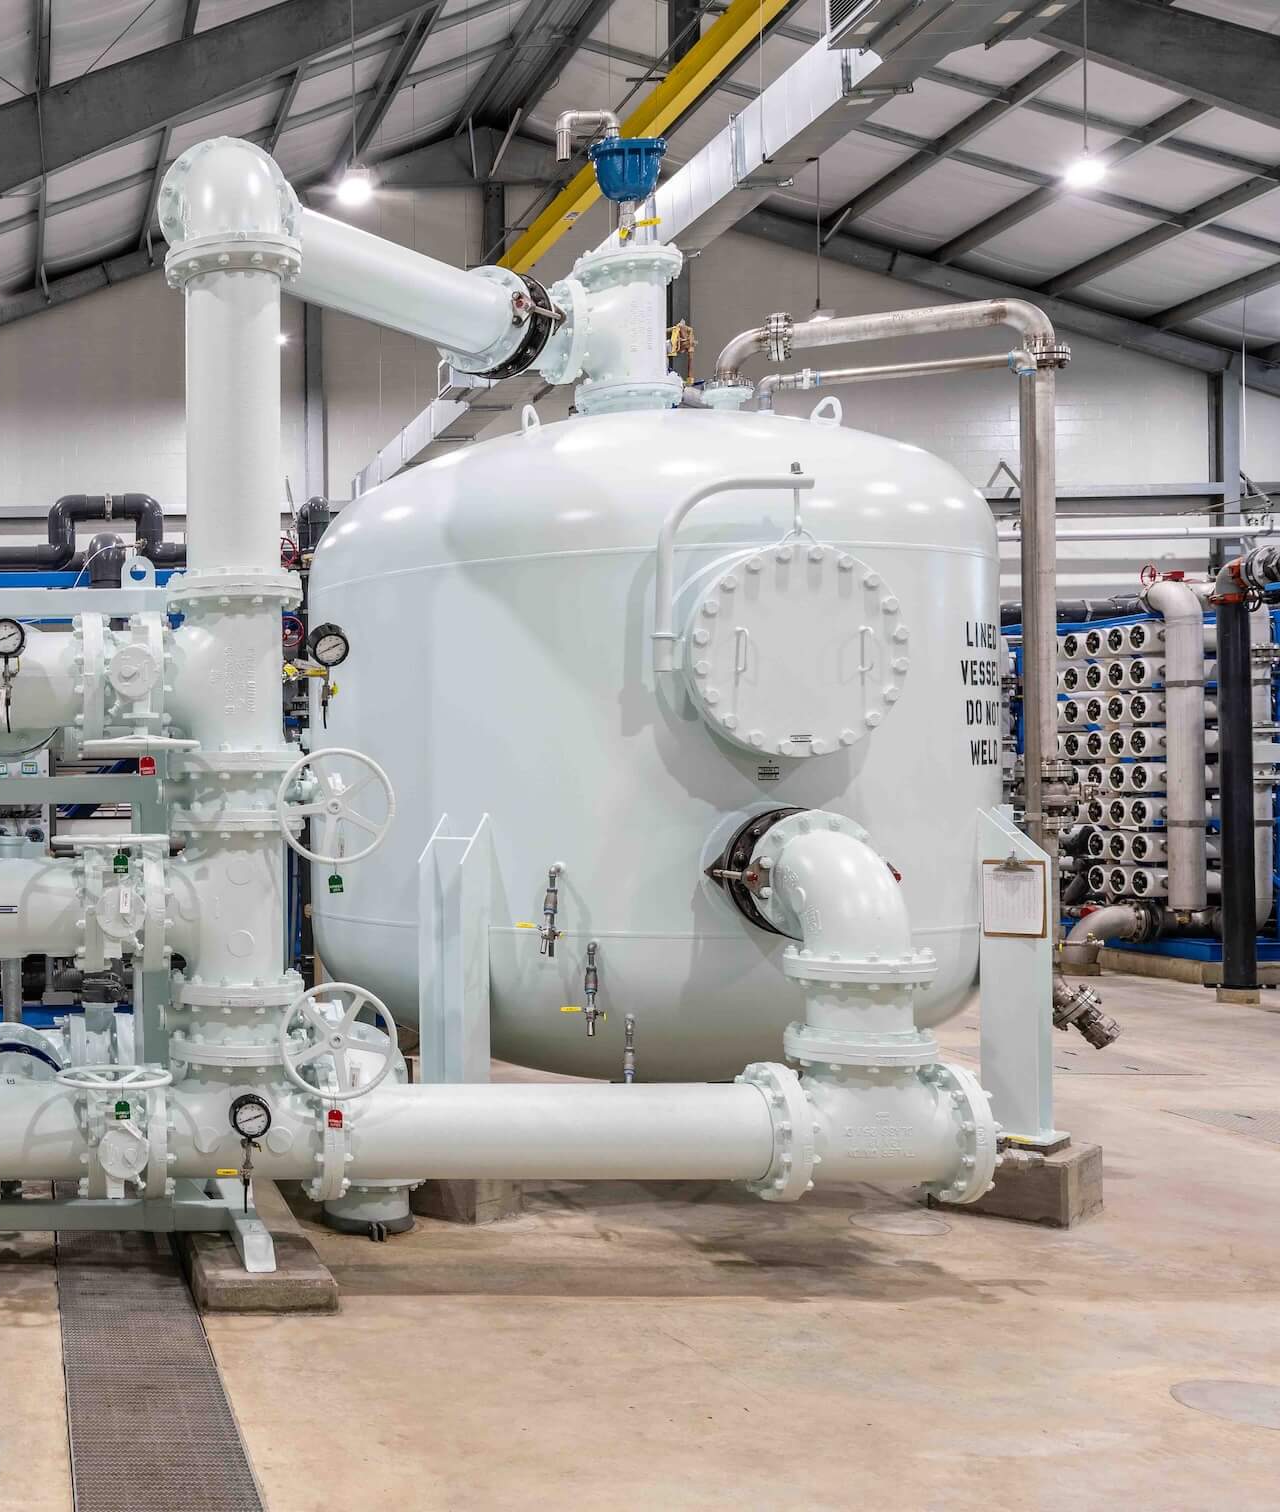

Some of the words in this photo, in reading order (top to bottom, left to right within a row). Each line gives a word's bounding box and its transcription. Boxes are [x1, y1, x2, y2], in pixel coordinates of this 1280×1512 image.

[966, 621, 997, 650] LINED
[961, 660, 1000, 687] VESSEL
[966, 700, 982, 726] DO
[986, 700, 1000, 726] NOT
[970, 740, 998, 766] WELD
